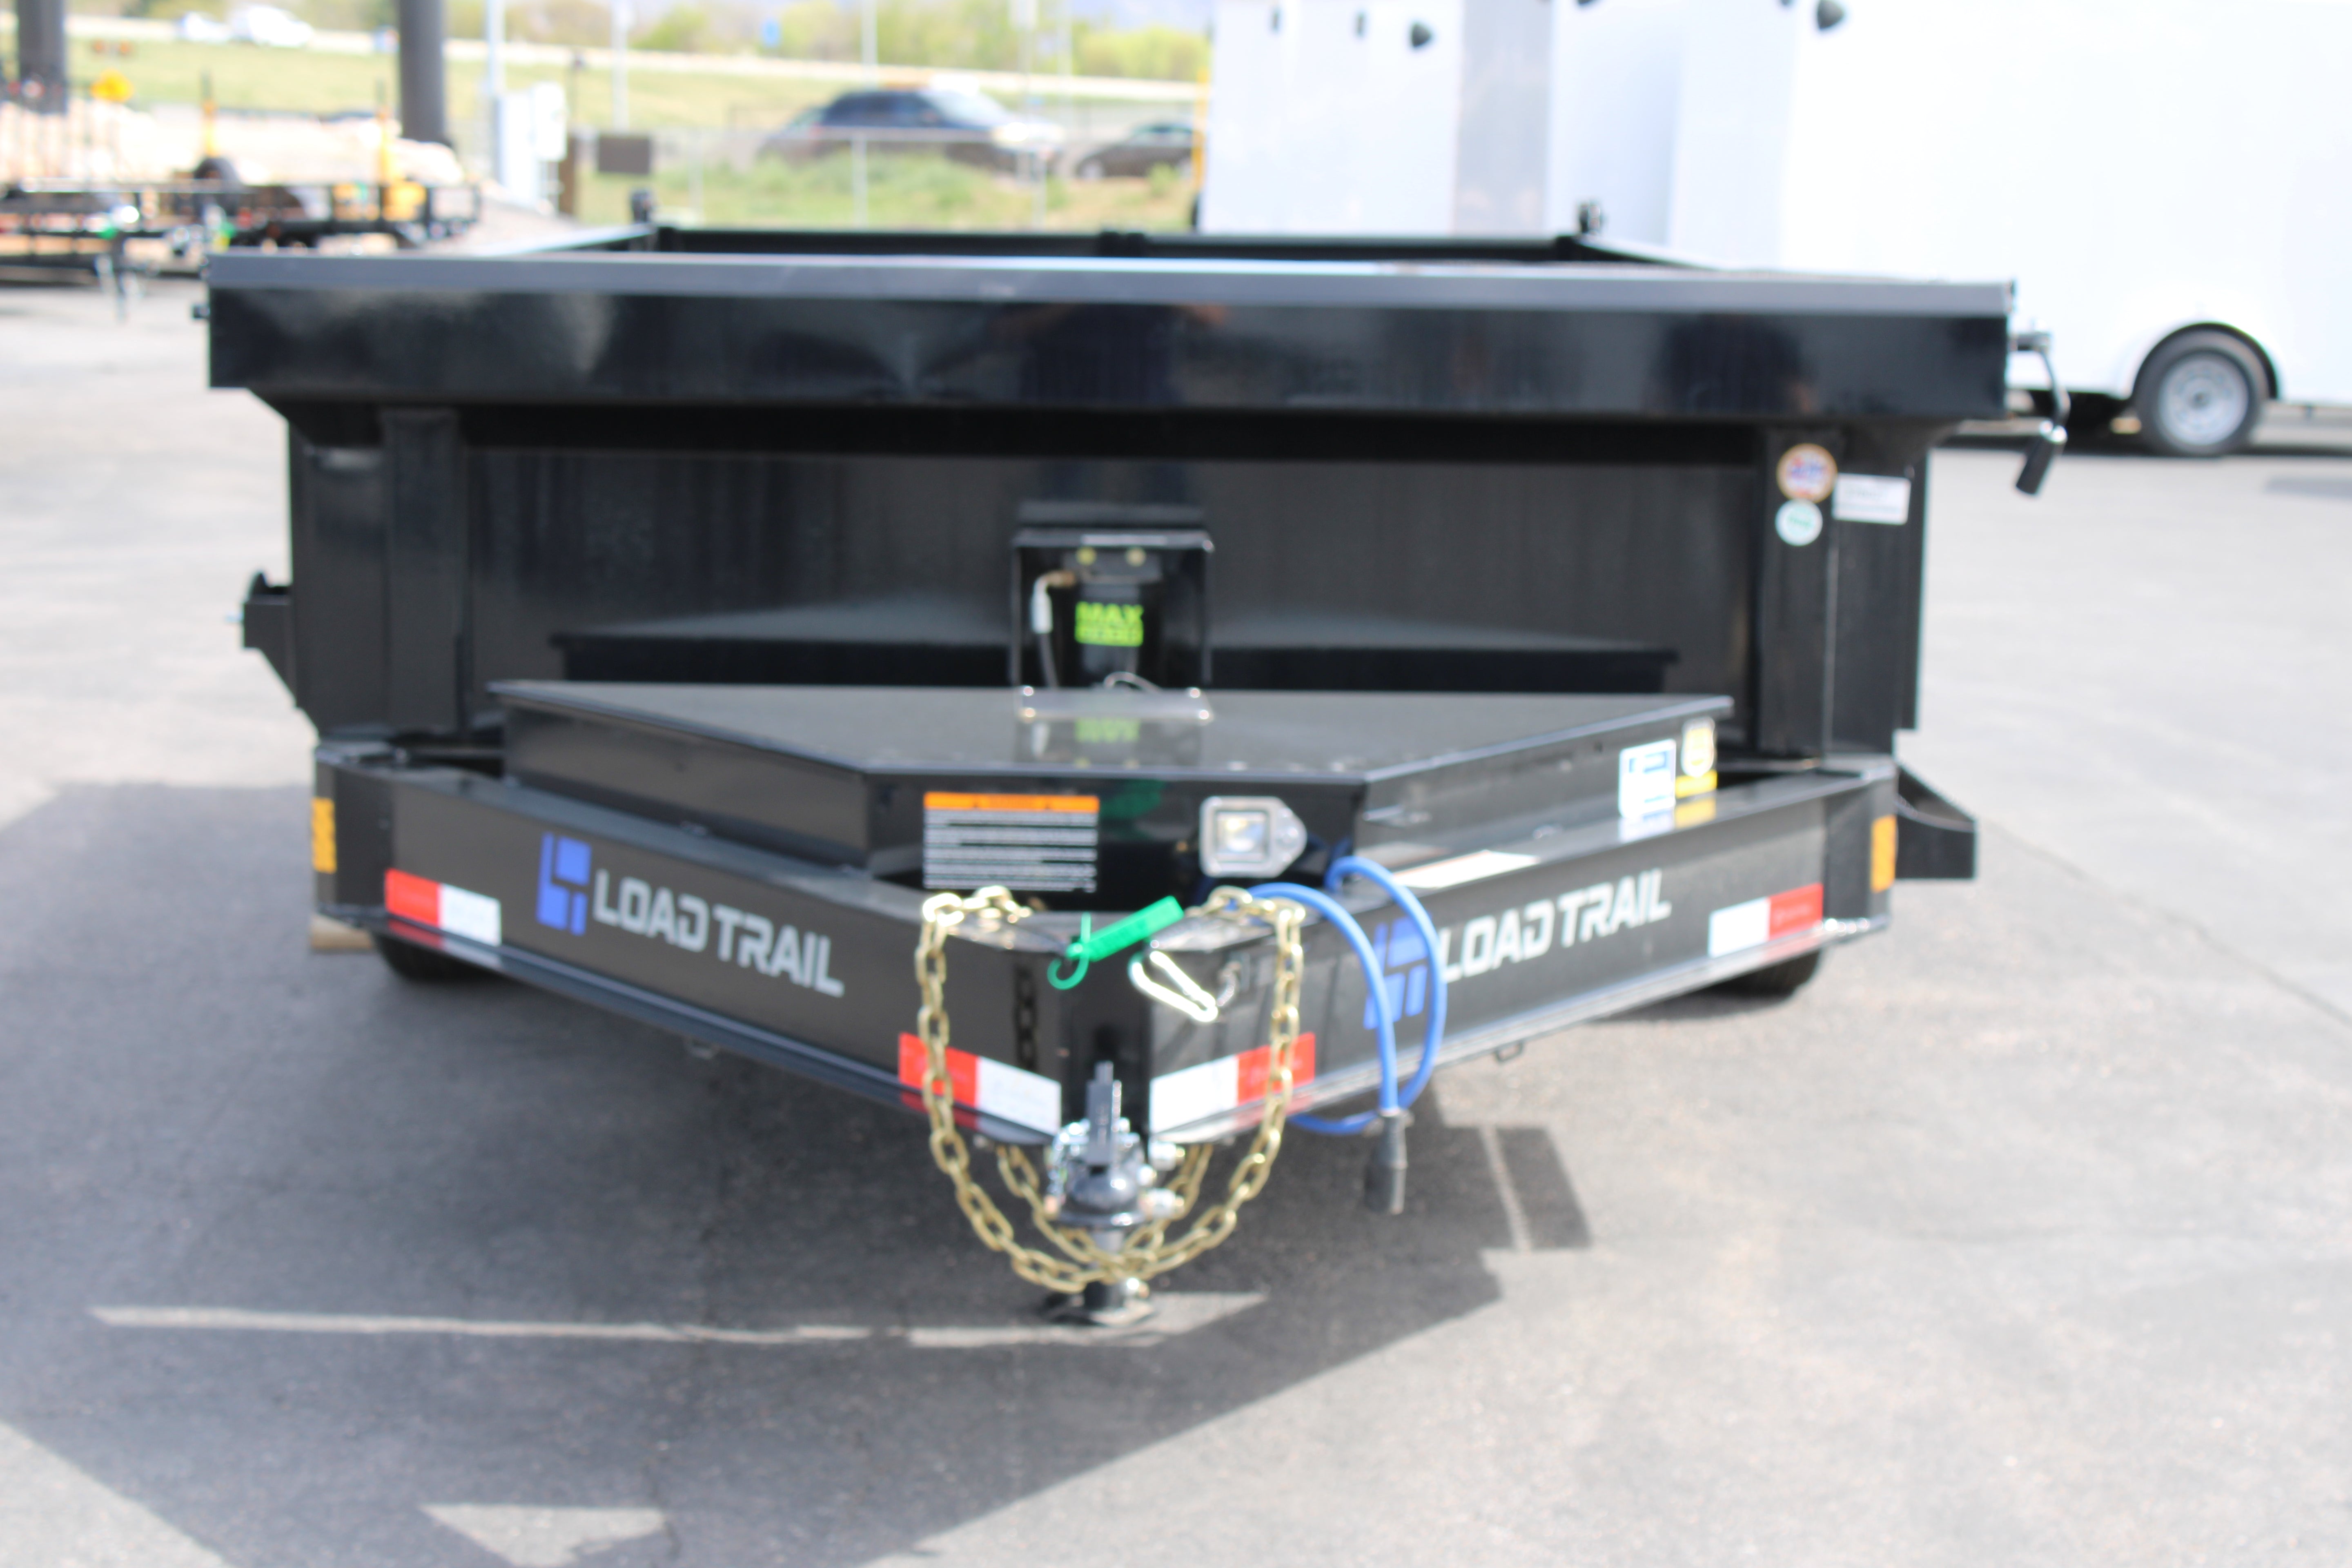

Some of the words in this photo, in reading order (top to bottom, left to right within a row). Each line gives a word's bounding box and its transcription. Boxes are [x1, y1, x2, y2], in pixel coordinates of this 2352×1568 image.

[1076, 601, 1144, 626] MAX
[592, 869, 710, 953] LOAD
[713, 904, 845, 998] TRAIL
[1441, 898, 1555, 983] LOAD
[1559, 868, 1672, 948] TRAIL
